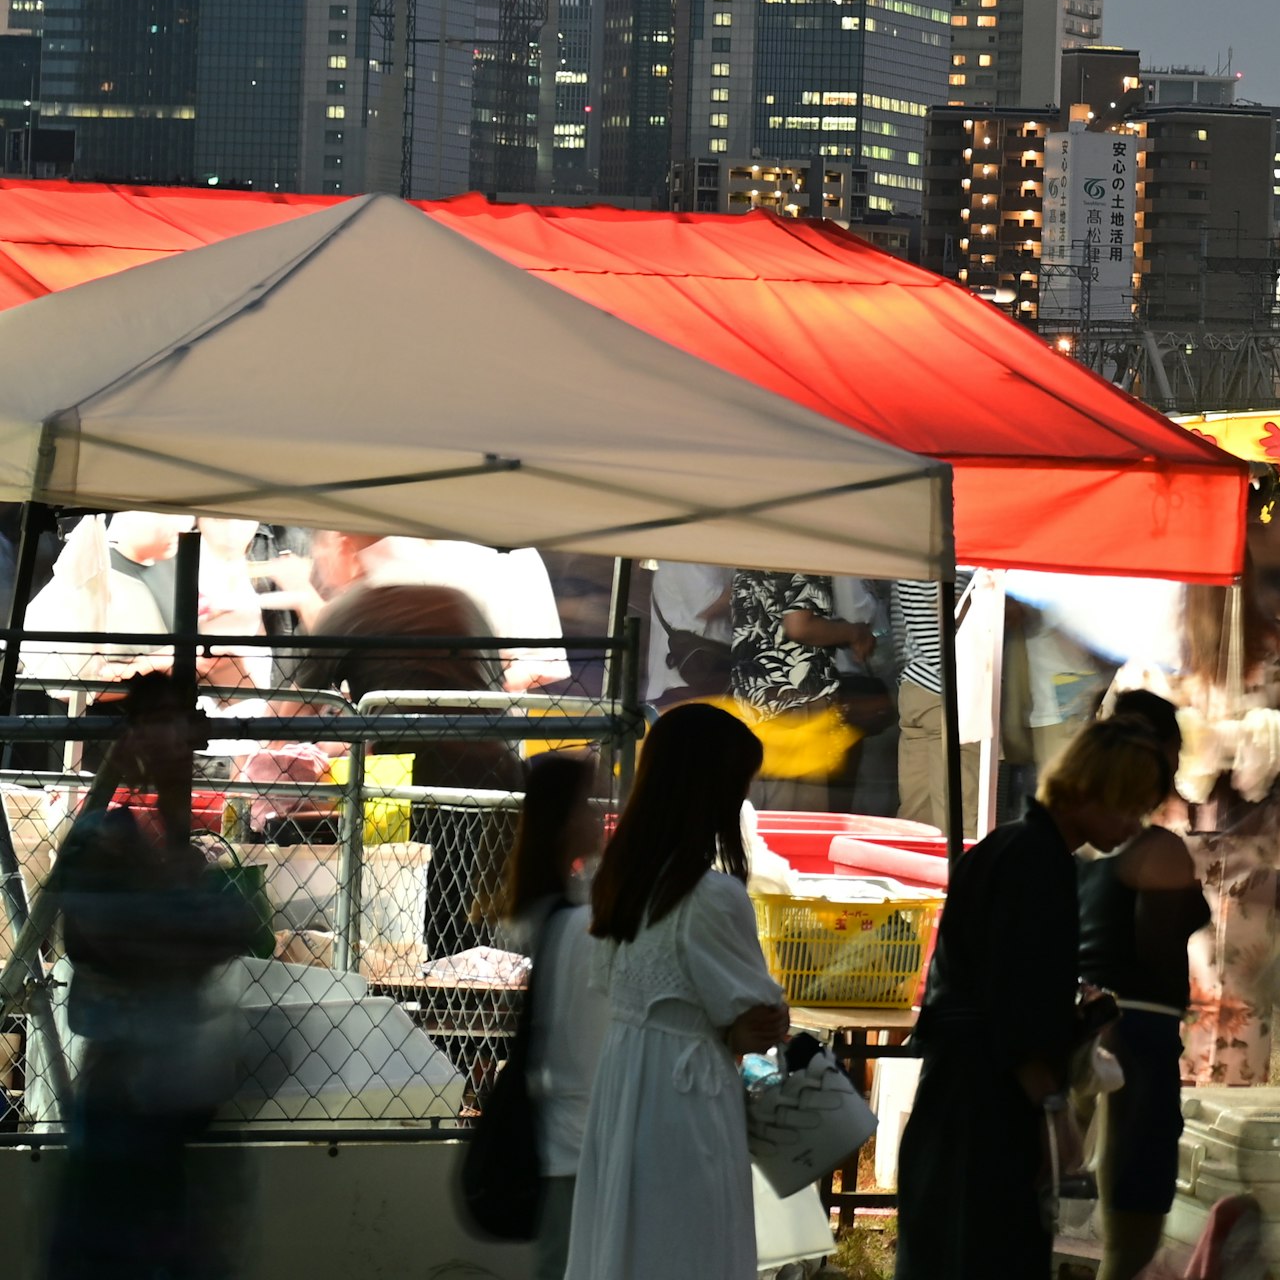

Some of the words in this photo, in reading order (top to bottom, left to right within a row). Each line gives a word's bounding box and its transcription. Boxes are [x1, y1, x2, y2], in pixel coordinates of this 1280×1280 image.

[1109, 142, 1127, 262] 安心の土地活用
[842, 910, 869, 918] スーパー
